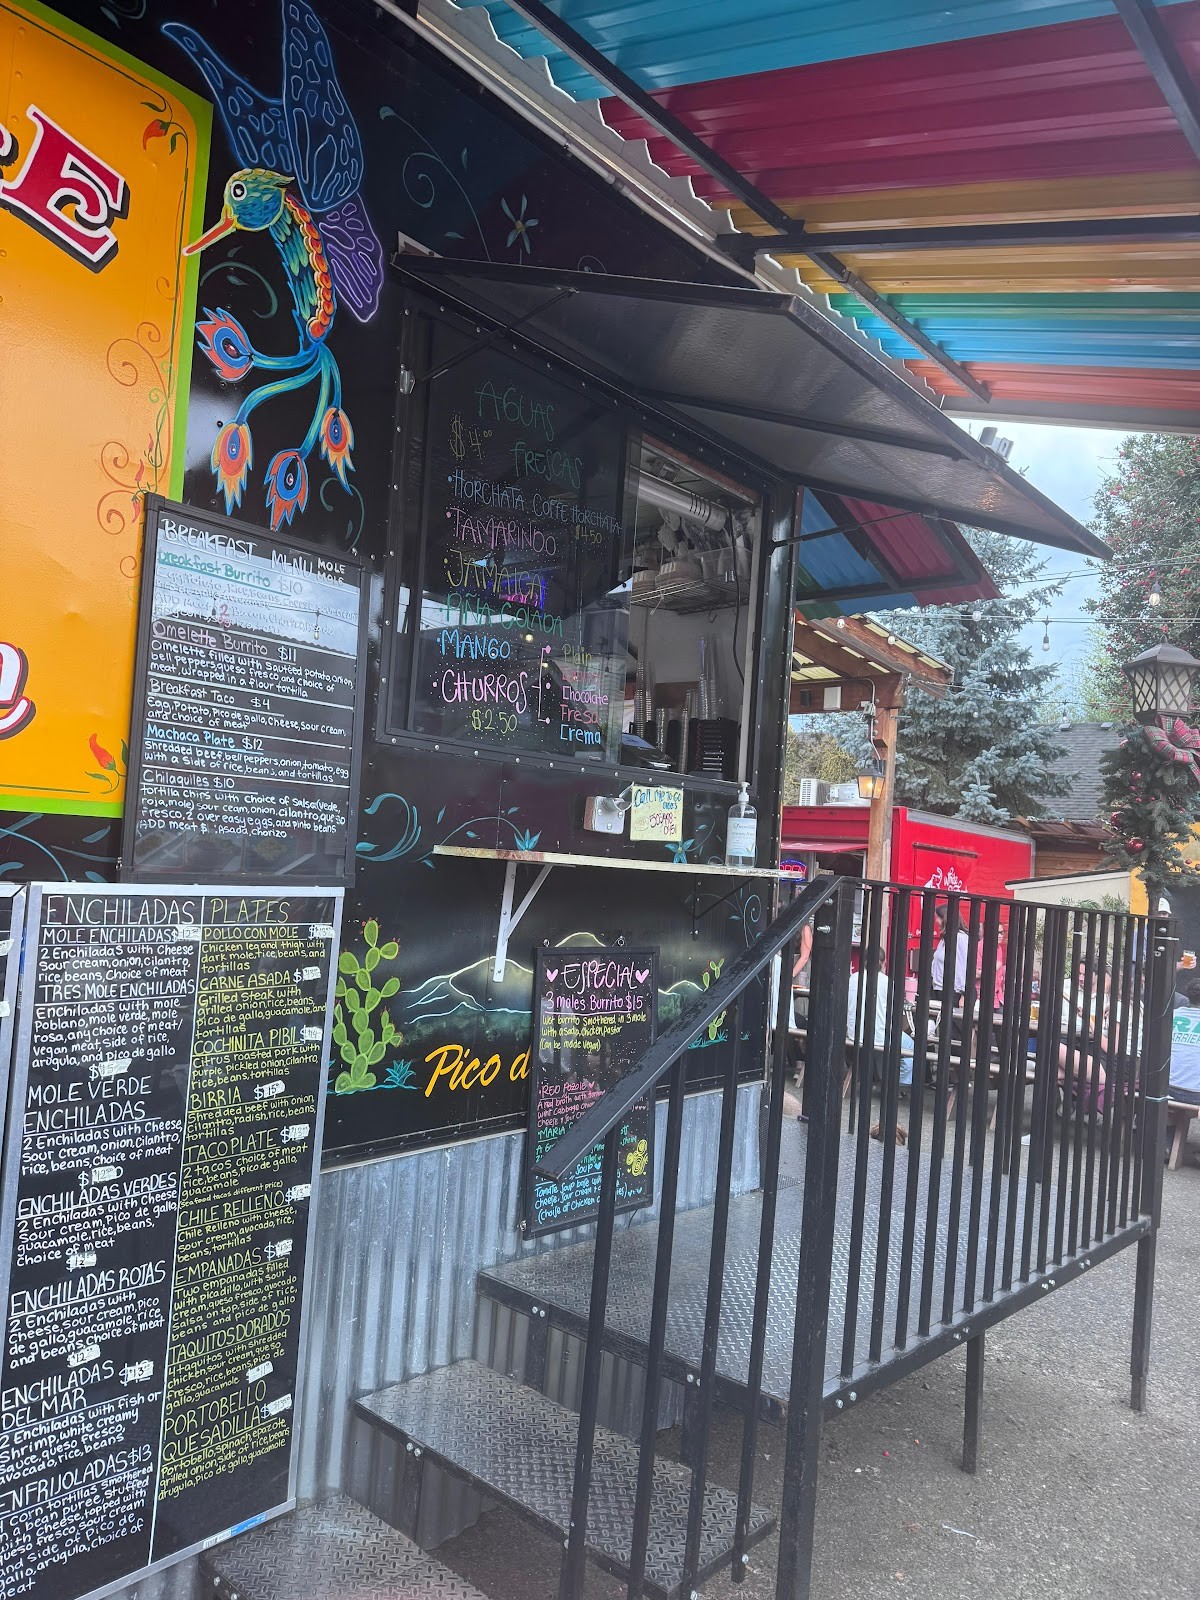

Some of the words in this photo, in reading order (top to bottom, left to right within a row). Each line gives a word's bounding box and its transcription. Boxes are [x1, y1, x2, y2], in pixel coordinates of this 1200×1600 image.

[475, 381, 556, 442] AGUAS
[452, 469, 525, 511] HORCHATA
[570, 505, 622, 534] HORCHATA
[450, 507, 556, 556] TAMARINDO
[161, 518, 257, 560] BREAKFAST
[271, 550, 313, 579] MENU
[224, 564, 271, 587] Burrito
[448, 549, 546, 599] JAMAICA
[151, 639, 206, 659] Omelette
[208, 650, 235, 664] filled
[238, 654, 262, 668] with
[152, 621, 217, 647] Omelette
[222, 633, 268, 655] Burrito
[278, 646, 296, 662] $11
[441, 629, 511, 659] MANGO
[150, 678, 207, 698] Breakfast
[211, 690, 235, 704] Taco
[251, 696, 270, 710] $4
[441, 669, 528, 714] CHURROS
[562, 686, 608, 705] Chocolate
[171, 712, 203, 723] choice
[209, 718, 220, 727] of
[223, 720, 248, 730] meat
[560, 704, 599, 724] Fresa
[146, 724, 200, 742] Machaca
[203, 731, 235, 749] Plate
[242, 737, 264, 750] $12
[561, 724, 600, 744] Crema
[142, 769, 210, 787] Chilaquiles
[213, 777, 235, 789] $10
[141, 785, 180, 798] tortilla
[215, 792, 240, 803] with
[279, 796, 290, 806] of
[46, 895, 195, 925] ENCHILADAS
[210, 898, 290, 924] PLATES
[42, 928, 85, 944] MOLE
[202, 943, 243, 953] Chicken
[246, 942, 260, 952] leg
[261, 941, 278, 949] and
[281, 941, 304, 950] thigh
[307, 938, 325, 948] with
[204, 928, 242, 940] POLLO
[243, 928, 267, 939] CON
[269, 927, 299, 939] MOLE
[41, 948, 50, 960] 2
[53, 944, 123, 960] Enchiladas
[127, 945, 153, 954] with
[200, 975, 245, 990] CARNE
[248, 970, 291, 988] ASADA
[201, 961, 250, 974] tortillas
[561, 960, 638, 994] ESPECIAL
[39, 984, 81, 1002] TRES
[84, 982, 117, 1000] MOLE
[120, 979, 195, 998] ENCHILADAS
[546, 991, 554, 1009] 3
[590, 994, 623, 1011] Burrito
[626, 992, 644, 1011] $15
[193, 1032, 265, 1054] COCHINITA
[270, 1027, 300, 1046] PIBIL
[195, 1025, 247, 1038] tortillas
[193, 1053, 230, 1069] Citrus
[234, 1048, 272, 1060] roasted
[274, 1046, 297, 1059] pork
[300, 1043, 320, 1053] with
[424, 1044, 501, 1097] Pico
[27, 1082, 83, 1108] MOLE
[88, 1076, 152, 1099] VERDE
[190, 1085, 242, 1110] BIRRIA
[23, 1100, 146, 1135] ENCHILADAS
[188, 1107, 242, 1123] Shredded
[245, 1101, 268, 1112] beef
[271, 1099, 289, 1107] with
[23, 1138, 32, 1150] 2
[36, 1129, 110, 1149] Enchiladas
[184, 1141, 228, 1164] TACO
[231, 1128, 278, 1156] PLATE
[18, 1183, 120, 1219] ENCHILADAS
[123, 1172, 177, 1197] VERDES
[182, 1179, 239, 1201] guacamole
[178, 1206, 220, 1228] CHILE
[223, 1191, 284, 1218] RELLENO
[83, 1240, 115, 1251] meat
[178, 1227, 203, 1243] Chile
[175, 1248, 261, 1286] EMPANADAS
[11, 1270, 115, 1316] ENCHILADAS
[119, 1260, 166, 1291] ROJAS
[174, 1286, 200, 1300] Two
[203, 1267, 264, 1290] empanadas
[170, 1327, 235, 1366] TAQUITOS
[236, 1309, 290, 1341] DORADOS
[1, 1360, 115, 1411] ENCHILADAS
[1, 1405, 38, 1431] DEL
[42, 1388, 87, 1419] MAR
[164, 1380, 266, 1440] PORTOBELLO
[163, 1405, 261, 1463] QUESADILLA
[0, 1451, 128, 1515] ENFRIJOLADAS
[128, 1444, 151, 1466] $13
